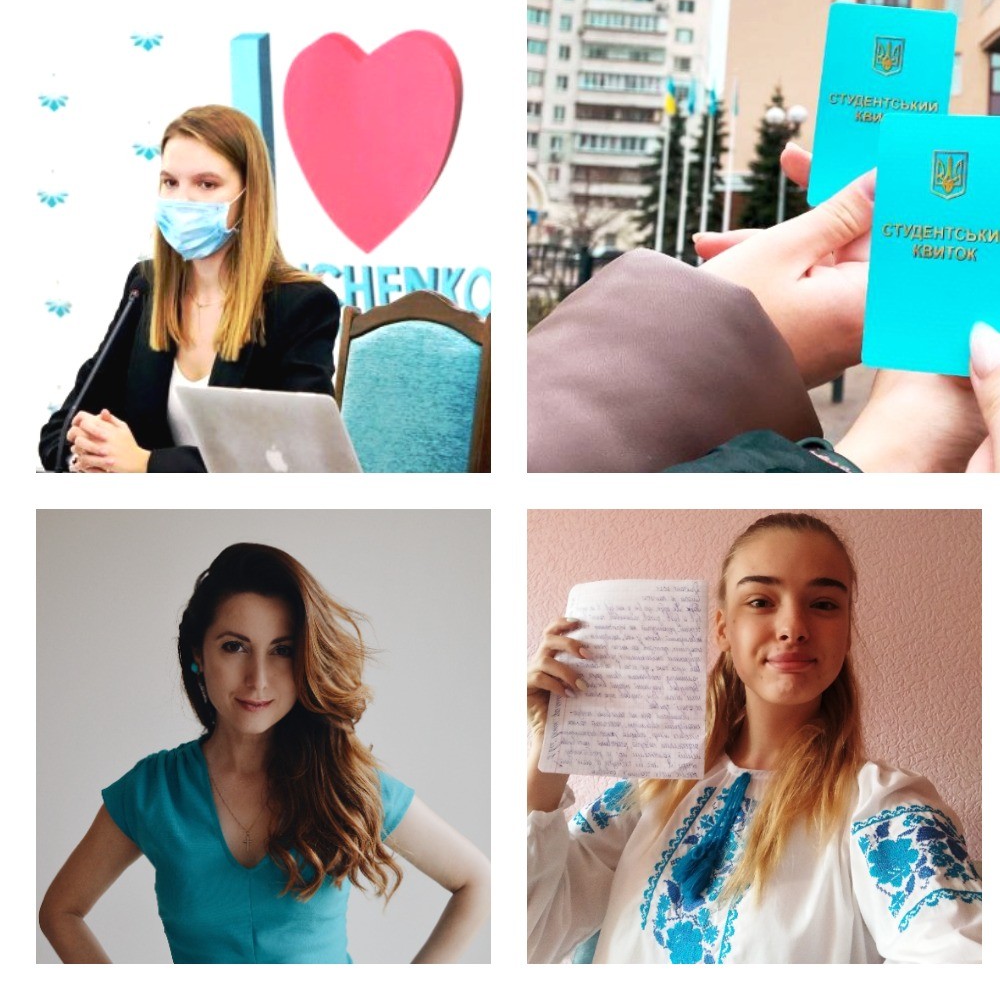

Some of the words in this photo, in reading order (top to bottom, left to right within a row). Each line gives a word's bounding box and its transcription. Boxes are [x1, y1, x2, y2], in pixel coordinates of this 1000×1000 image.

[828, 92, 939, 114] СТУДЕНТСЬКИЙ
[854, 110, 885, 124] КВИ
[912, 243, 978, 262] КВИТОК
